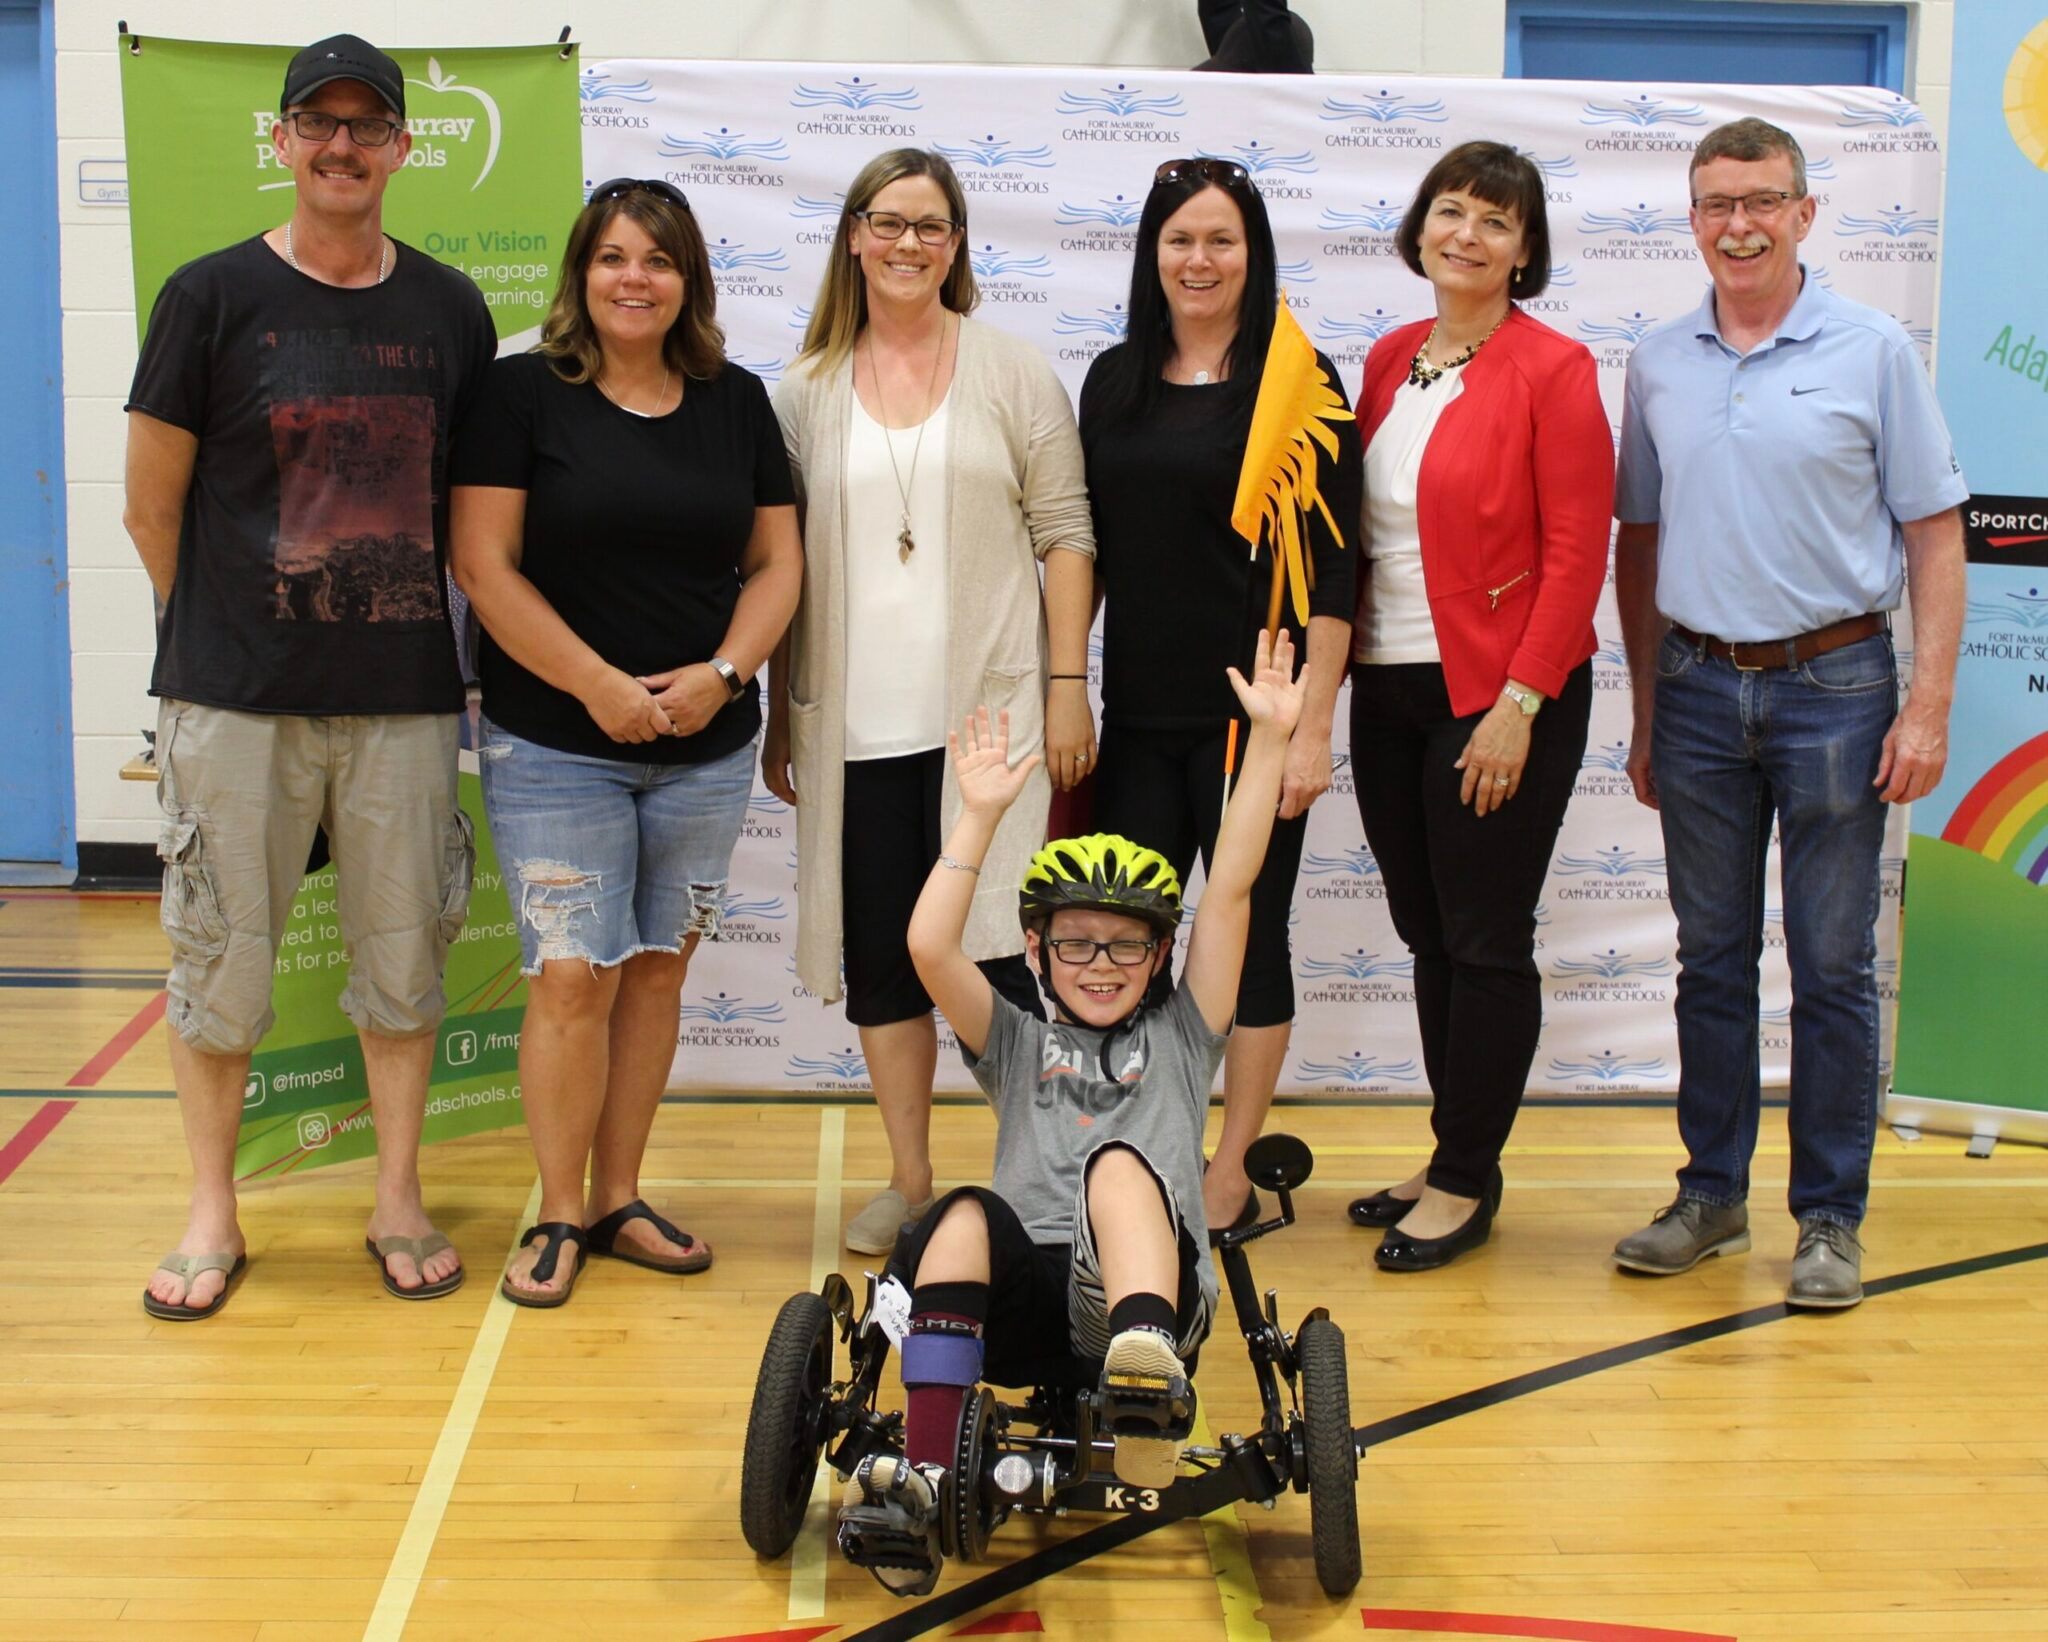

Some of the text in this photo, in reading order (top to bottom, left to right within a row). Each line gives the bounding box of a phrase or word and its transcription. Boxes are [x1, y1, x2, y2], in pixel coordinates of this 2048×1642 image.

[592, 115, 649, 128] SCHOOLS
[823, 113, 890, 123] FORT McMURRAY
[858, 123, 915, 137] SCHOOLS
[1088, 120, 1155, 129] FORT McMURRAY
[1123, 130, 1180, 143] SCHOOLS
[1350, 127, 1417, 135] FORT McMURRAY
[1611, 131, 1630, 139] FORT
[1868, 132, 1932, 141] FORT McMURRAY
[1386, 136, 1441, 149] SCHOOLS
[690, 163, 758, 173] FORT McMURRAY
[727, 174, 784, 187] SCHOOLS
[979, 171, 1024, 180] McMURRAY
[992, 181, 1049, 194] SCHOOLS
[1254, 178, 1287, 186] MURRAY
[97, 188, 121, 201] Gym
[425, 230, 547, 254] Our Vision
[1349, 235, 1369, 244] FORT
[1608, 239, 1673, 248] FORT McMURRAY
[1864, 241, 1928, 250] FORT McMURRAY
[1642, 248, 1698, 261] SCHOOLS
[470, 263, 549, 283] engage
[727, 284, 783, 297] SCHOOLS
[483, 287, 549, 308] arning.
[991, 291, 1048, 303] SCHOOLS
[1520, 300, 1569, 312] CHOOLS
[1085, 340, 1105, 348] FORT
[1346, 344, 1366, 353] FORT
[376, 345, 406, 367] THE
[1604, 348, 1624, 356] FORT
[1988, 632, 2014, 643] FORT
[739, 827, 782, 839] HOOLS
[1331, 879, 1350, 887] FORT
[1583, 880, 1646, 888] FORT McMURRAY
[1616, 889, 1669, 900] SCHOOLS
[319, 925, 338, 940] to
[727, 931, 781, 944] SCHOOLS
[296, 952, 321, 971] for
[1328, 982, 1392, 991] FORT McMURRAY
[1599, 982, 1641, 990] McMURRAY
[1612, 990, 1666, 1002] SCHOOLS
[690, 1026, 755, 1035] FORT McMURRAY
[724, 1036, 780, 1047] SCHOOLS
[272, 1063, 345, 1092] @fmpsd
[816, 1082, 836, 1090] FORT
[1325, 1085, 1345, 1093] FORT
[1597, 1084, 1639, 1092] McMURRAY
[1104, 1487, 1160, 1512] K-3
